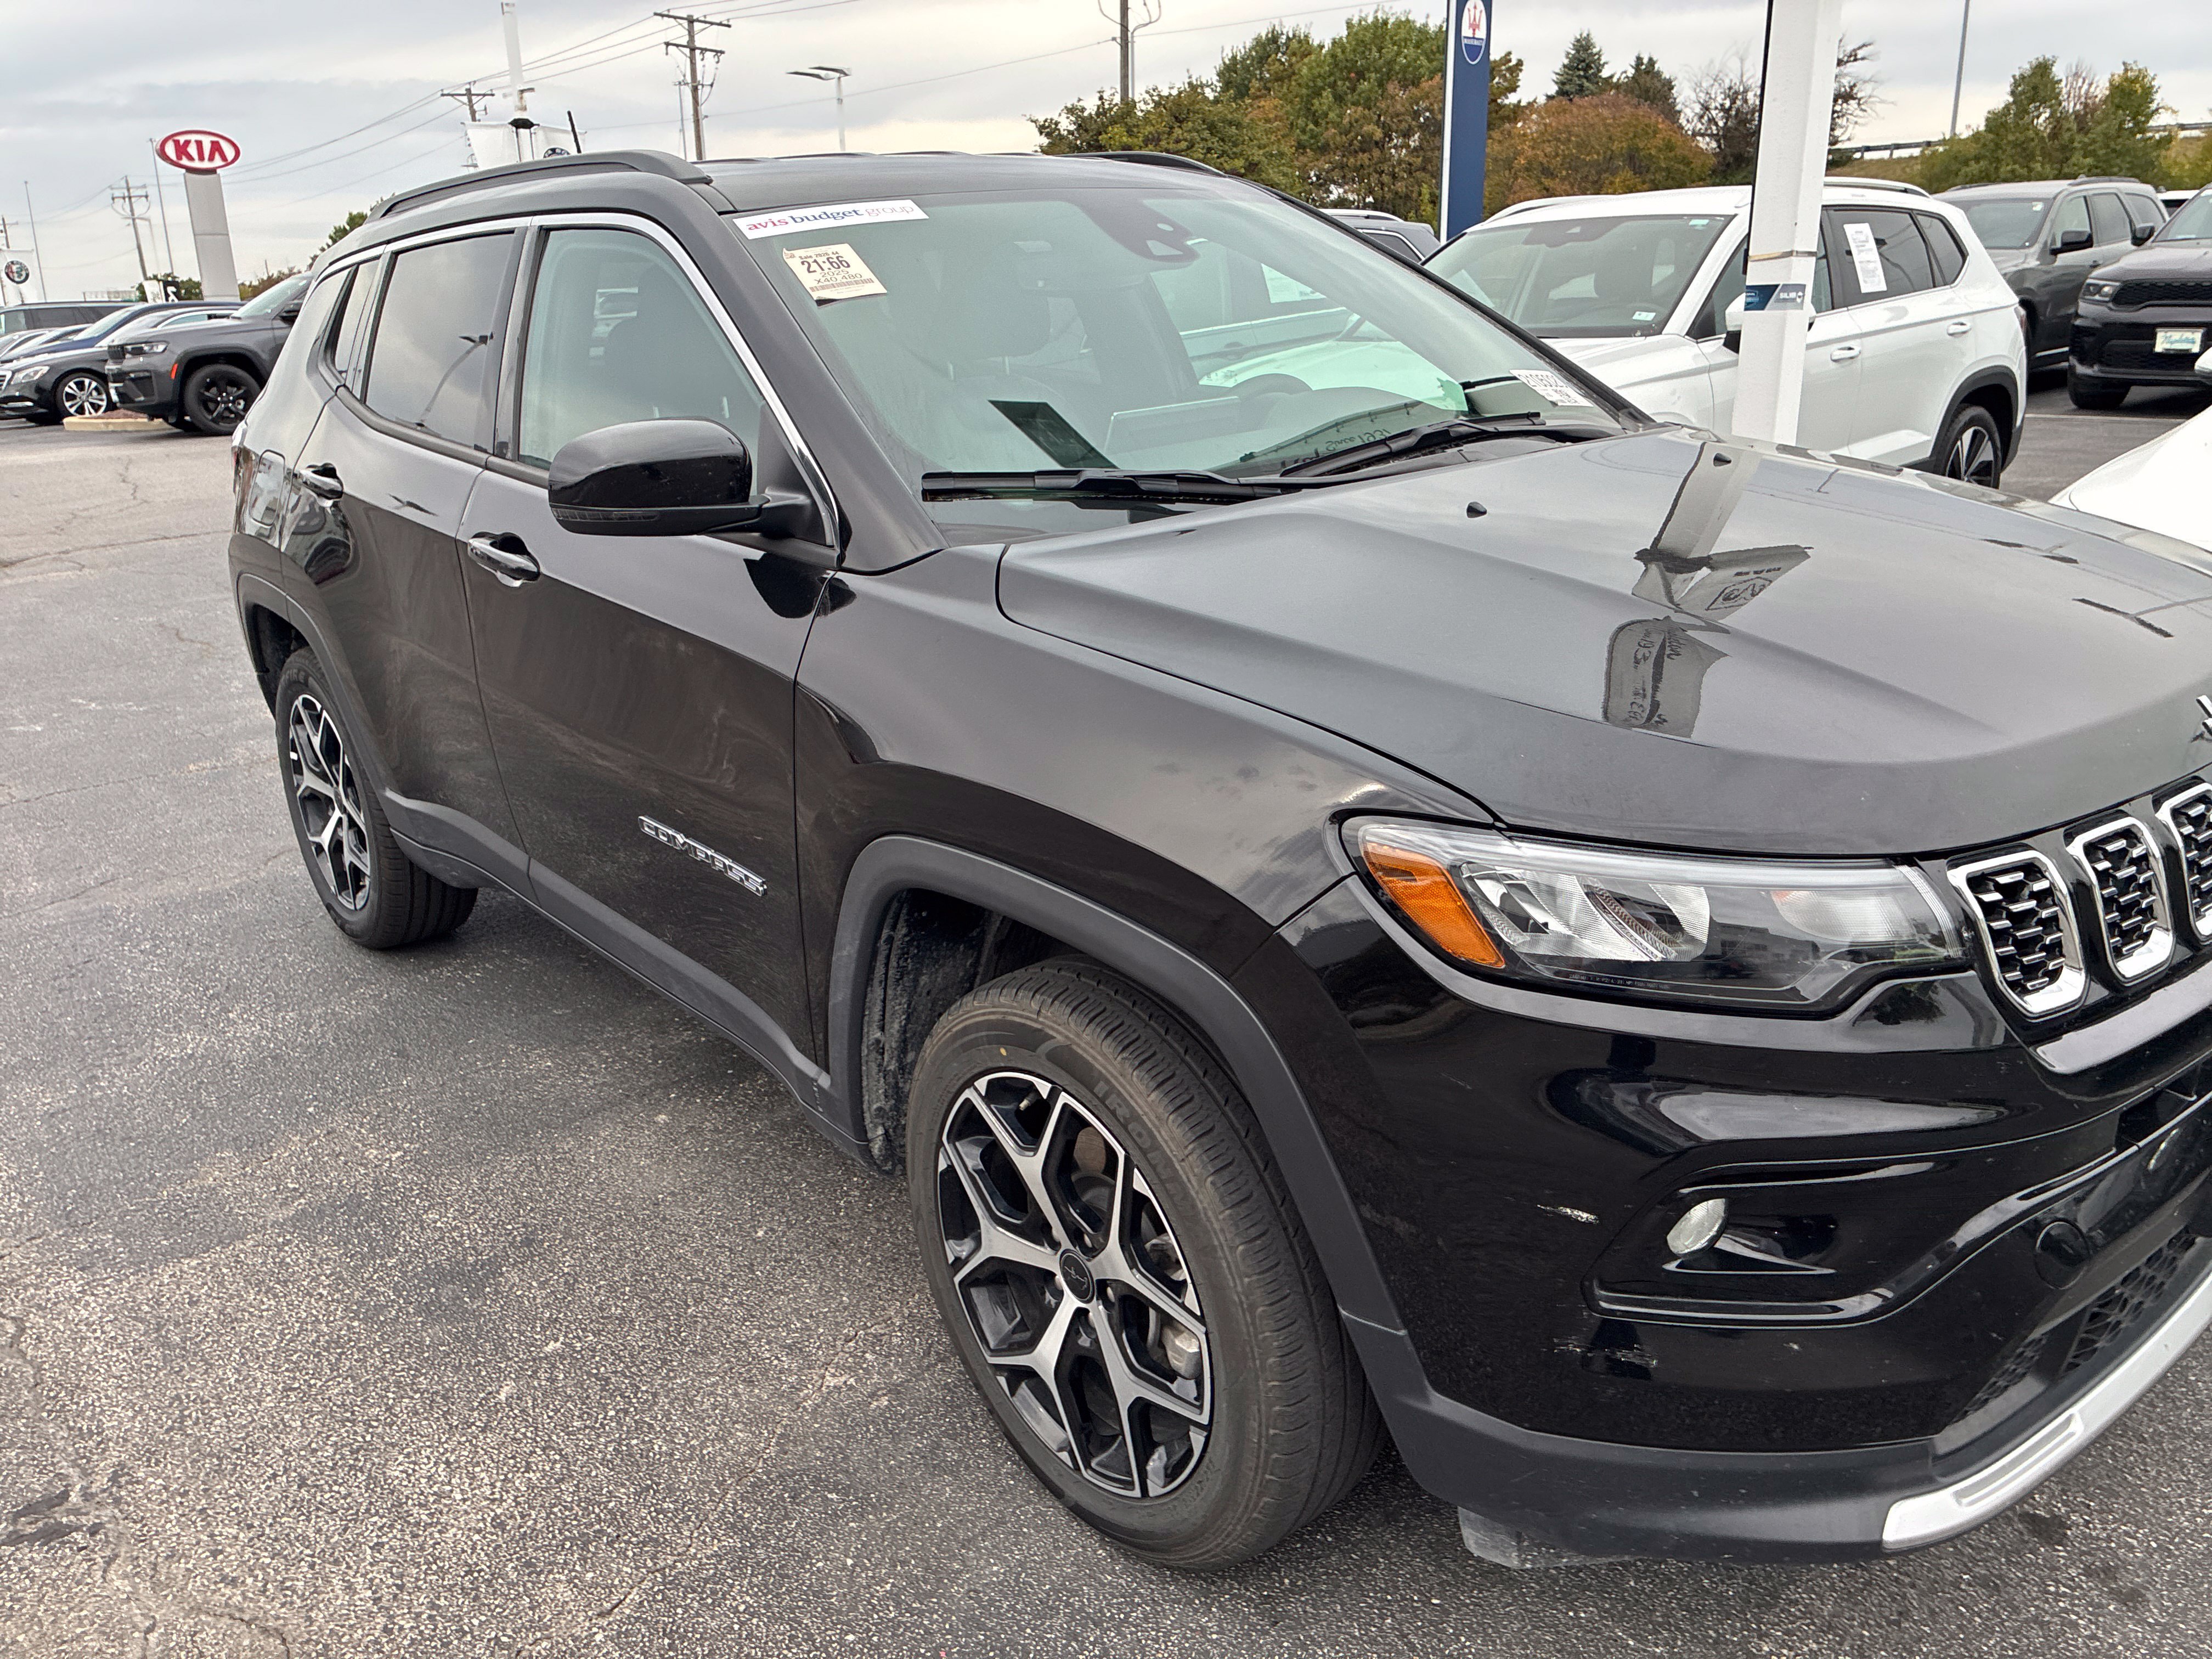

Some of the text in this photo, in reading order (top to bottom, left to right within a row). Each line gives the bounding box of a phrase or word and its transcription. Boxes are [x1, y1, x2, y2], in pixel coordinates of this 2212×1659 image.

[172, 139, 228, 162] KIA
[746, 206, 914, 230] avis budget group
[800, 256, 850, 273] 21:66
[820, 269, 849, 278] 2025
[814, 273, 862, 284] X40,480
[638, 815, 767, 896] COMPASS
